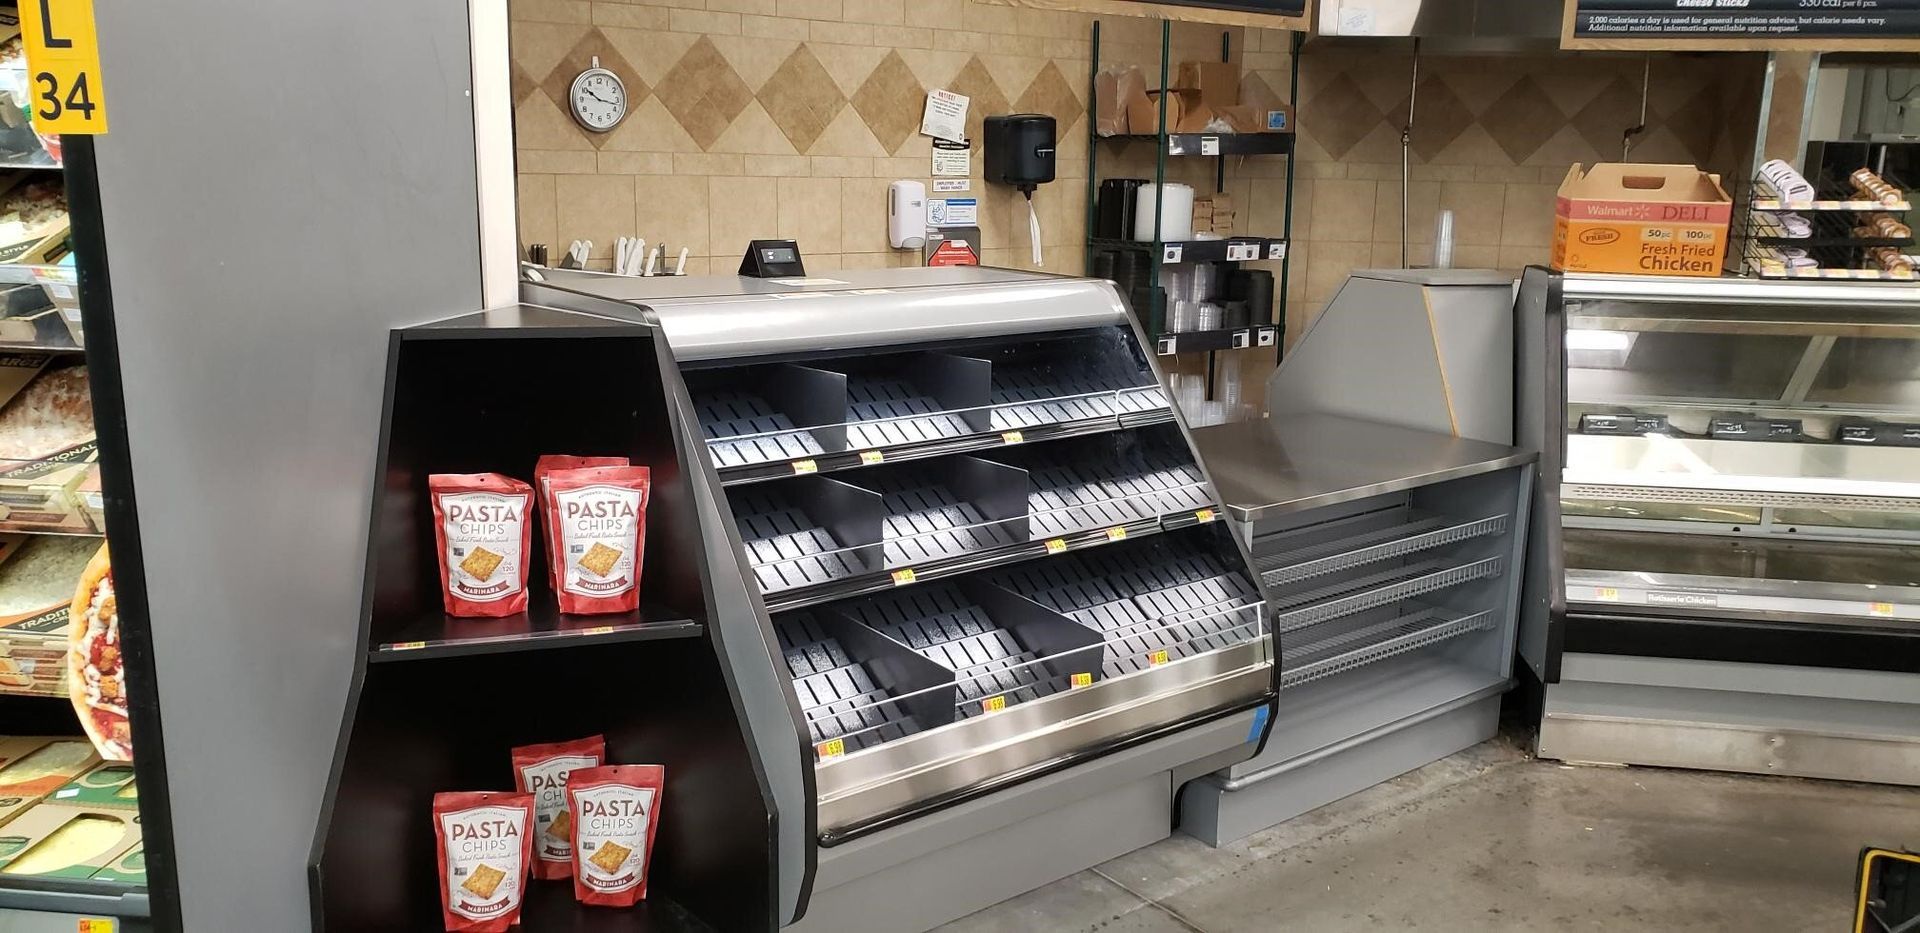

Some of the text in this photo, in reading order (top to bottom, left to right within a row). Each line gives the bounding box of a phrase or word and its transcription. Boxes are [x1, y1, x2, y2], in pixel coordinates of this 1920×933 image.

[1608, 16, 1638, 24] calories
[1646, 16, 1661, 25] day
[1671, 16, 1689, 24] used
[1702, 16, 1733, 25] general
[1734, 16, 1768, 24] nutrition
[1799, 16, 1812, 24] but
[1867, 18, 1886, 26] vary.
[1664, 24, 1708, 32] information
[1709, 24, 1747, 32] available
[1768, 25, 1800, 33] request.
[35, 71, 96, 121] 34
[1587, 204, 1711, 220] Walmart DELI
[1641, 243, 1717, 257] Fresh Fried
[1639, 255, 1714, 272] Chicken
[8, 443, 98, 479] TRADITIONAL
[450, 505, 517, 522] PASTA
[567, 500, 634, 518] PASTA
[460, 524, 505, 535] CHIPS
[577, 520, 623, 531] CHIPS
[463, 586, 500, 595] MARINARA
[584, 582, 620, 590] MARINARA
[1648, 594, 1716, 605] Rotisserie Chicken
[18, 607, 70, 630] TRADITI
[532, 770, 569, 791] PAS
[583, 800, 645, 817] PASTA
[452, 820, 518, 841] PASTA
[591, 819, 633, 829] CHIPS
[462, 839, 506, 853] CHIPS
[593, 879, 627, 888] MARINARA
[467, 903, 503, 912] MARINARA
